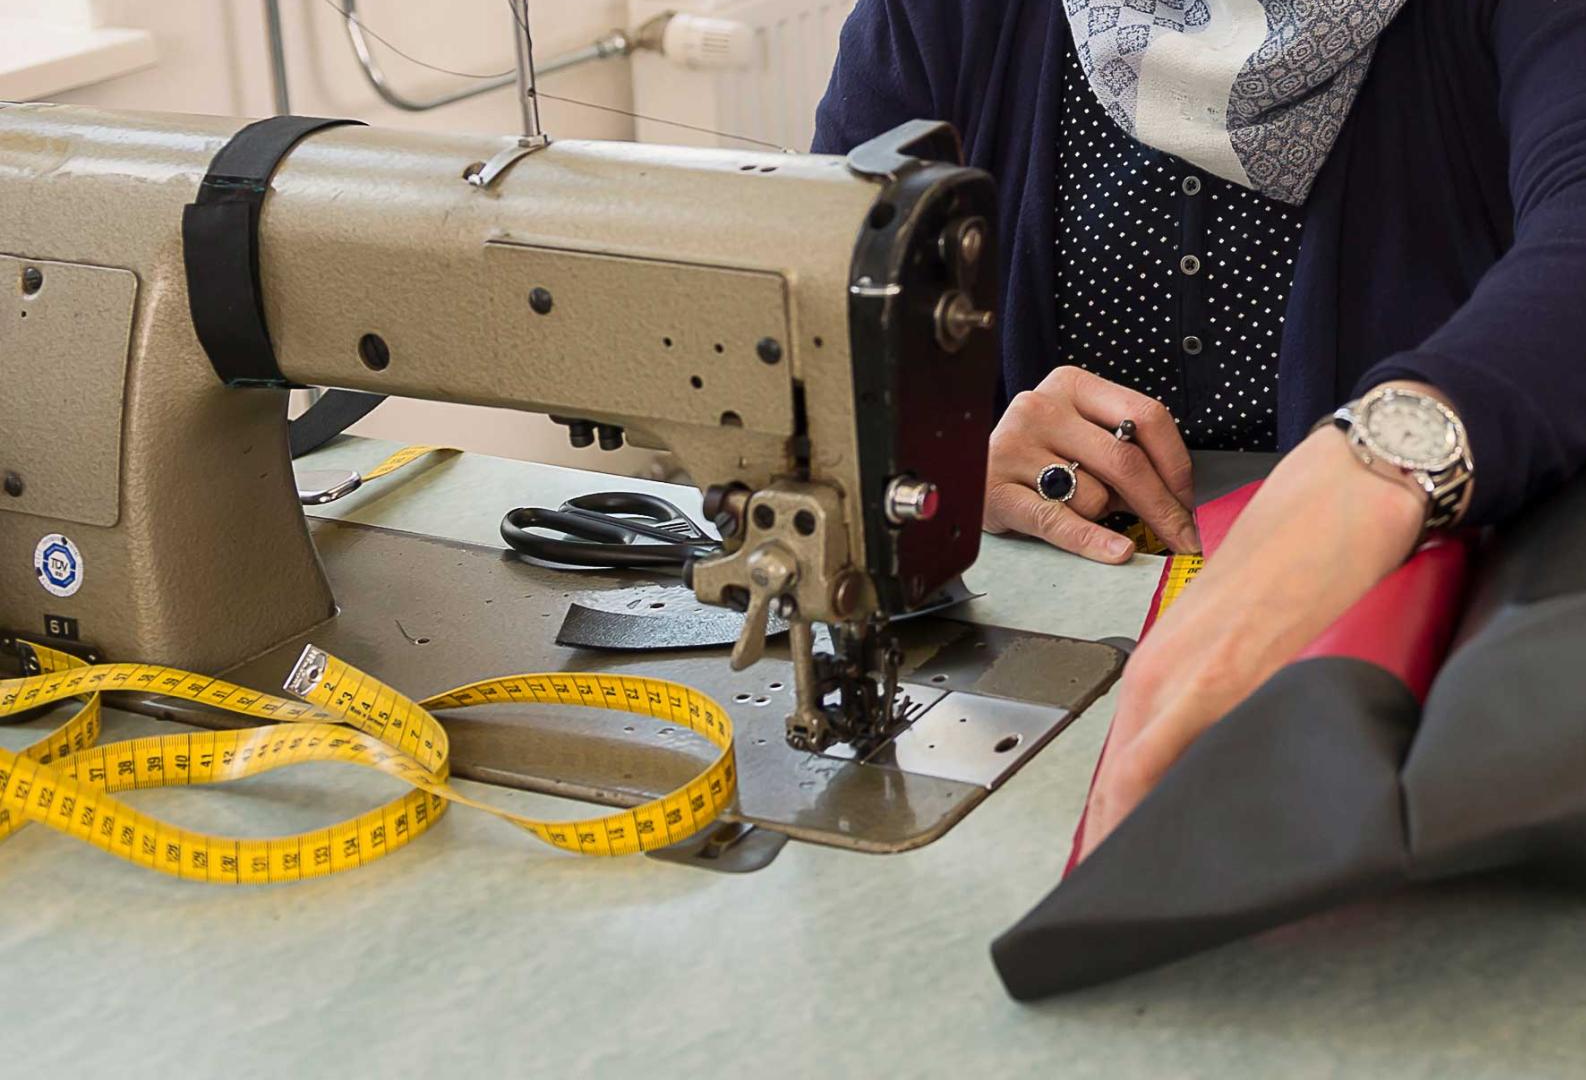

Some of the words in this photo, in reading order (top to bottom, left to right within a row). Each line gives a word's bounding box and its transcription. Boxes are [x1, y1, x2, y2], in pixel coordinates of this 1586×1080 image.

[50, 620, 69, 635] 61
[324, 682, 335, 691] 2
[342, 692, 353, 701] 3
[361, 701, 371, 711] 4
[378, 711, 389, 720] 5
[601, 685, 616, 696] 74
[624, 687, 640, 700] 73
[648, 691, 662, 704] 72
[669, 695, 682, 708] 71
[88, 767, 105, 782] 37
[118, 760, 133, 775] 38
[147, 756, 162, 772] 39
[174, 754, 189, 770] 40
[200, 753, 213, 768] 41
[222, 750, 235, 765] 42
